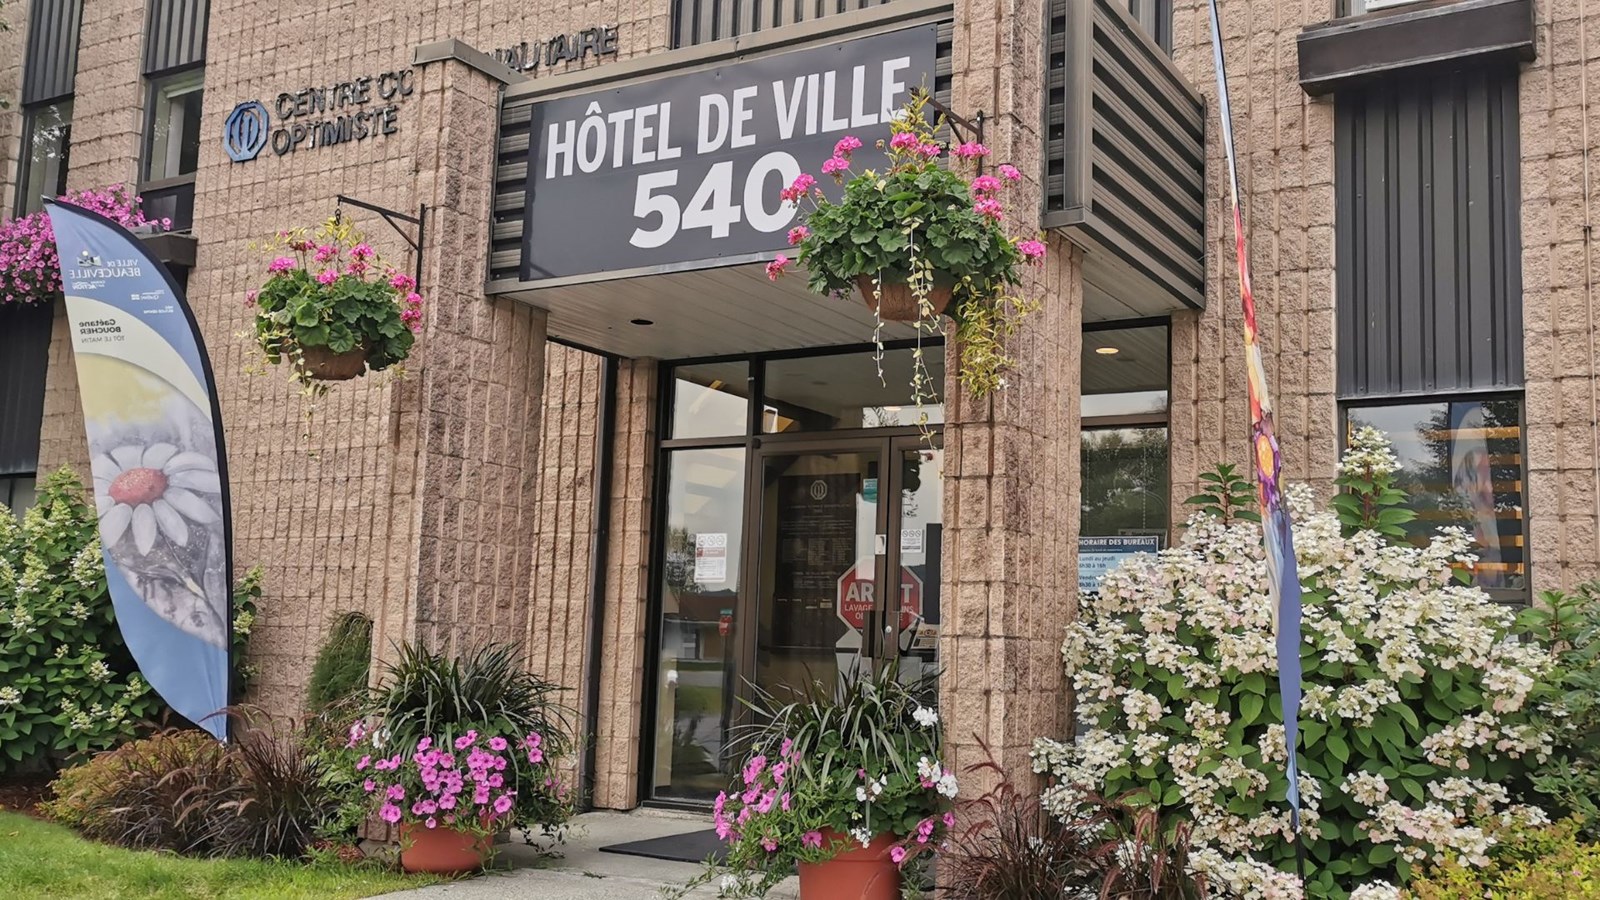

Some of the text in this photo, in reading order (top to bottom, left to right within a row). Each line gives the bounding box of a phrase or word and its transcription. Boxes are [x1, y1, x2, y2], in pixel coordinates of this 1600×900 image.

[275, 75, 372, 120] CENTRE
[486, 23, 619, 73] AUTAIRE
[271, 104, 398, 155] OPTIMISTE
[545, 56, 911, 180] HÔTEL DE VILLE
[629, 151, 801, 249] 540
[1123, 538, 1155, 546] BUREAUX
[845, 581, 914, 604] ART
